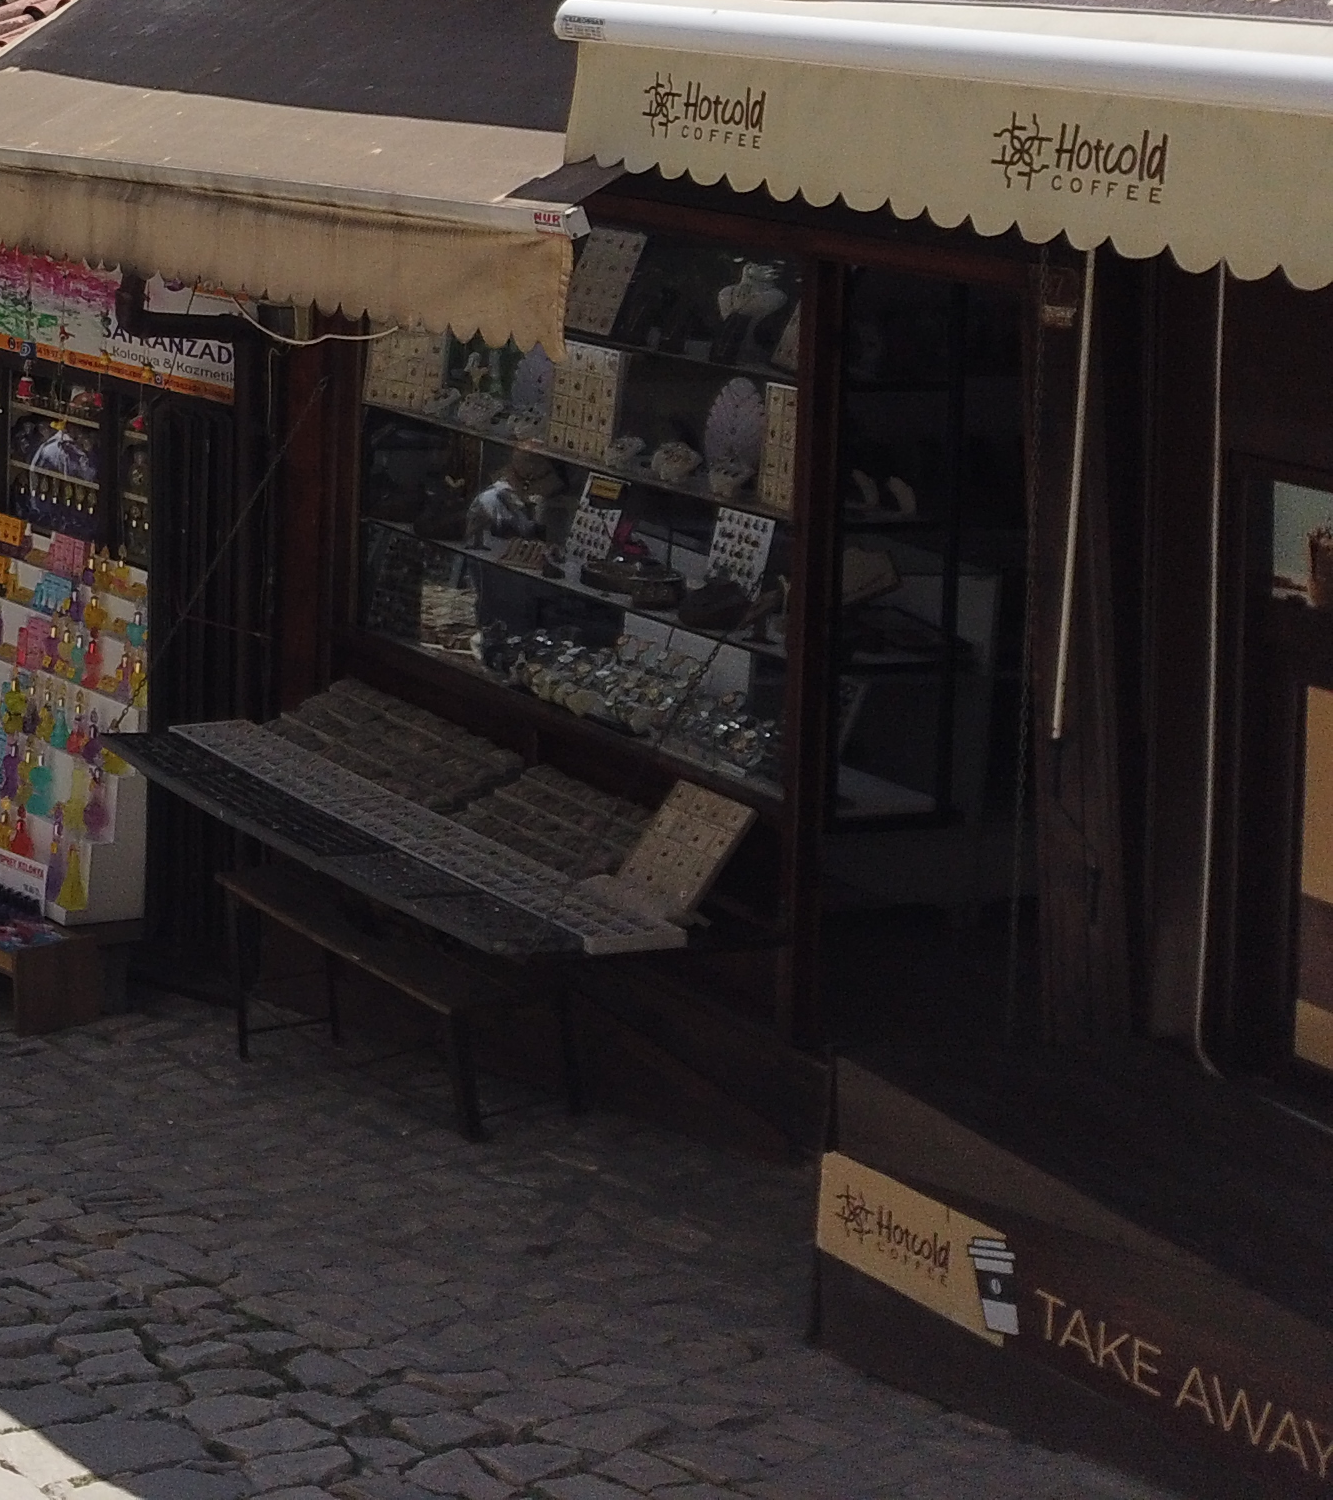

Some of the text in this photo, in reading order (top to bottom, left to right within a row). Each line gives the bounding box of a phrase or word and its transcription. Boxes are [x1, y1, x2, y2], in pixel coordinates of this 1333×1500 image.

[683, 79, 766, 135] Hotcold
[679, 125, 763, 151] COFFEE
[1054, 122, 1169, 185] Hotcold
[1050, 176, 1164, 206] COFFEE
[533, 212, 561, 224] NUR
[102, 320, 234, 365] SAFRANZAD
[111, 345, 161, 369] Kolonya
[163, 358, 173, 369] &
[876, 1204, 951, 1275] Hotcold
[1033, 1287, 1333, 1480] TAKE AWAY
